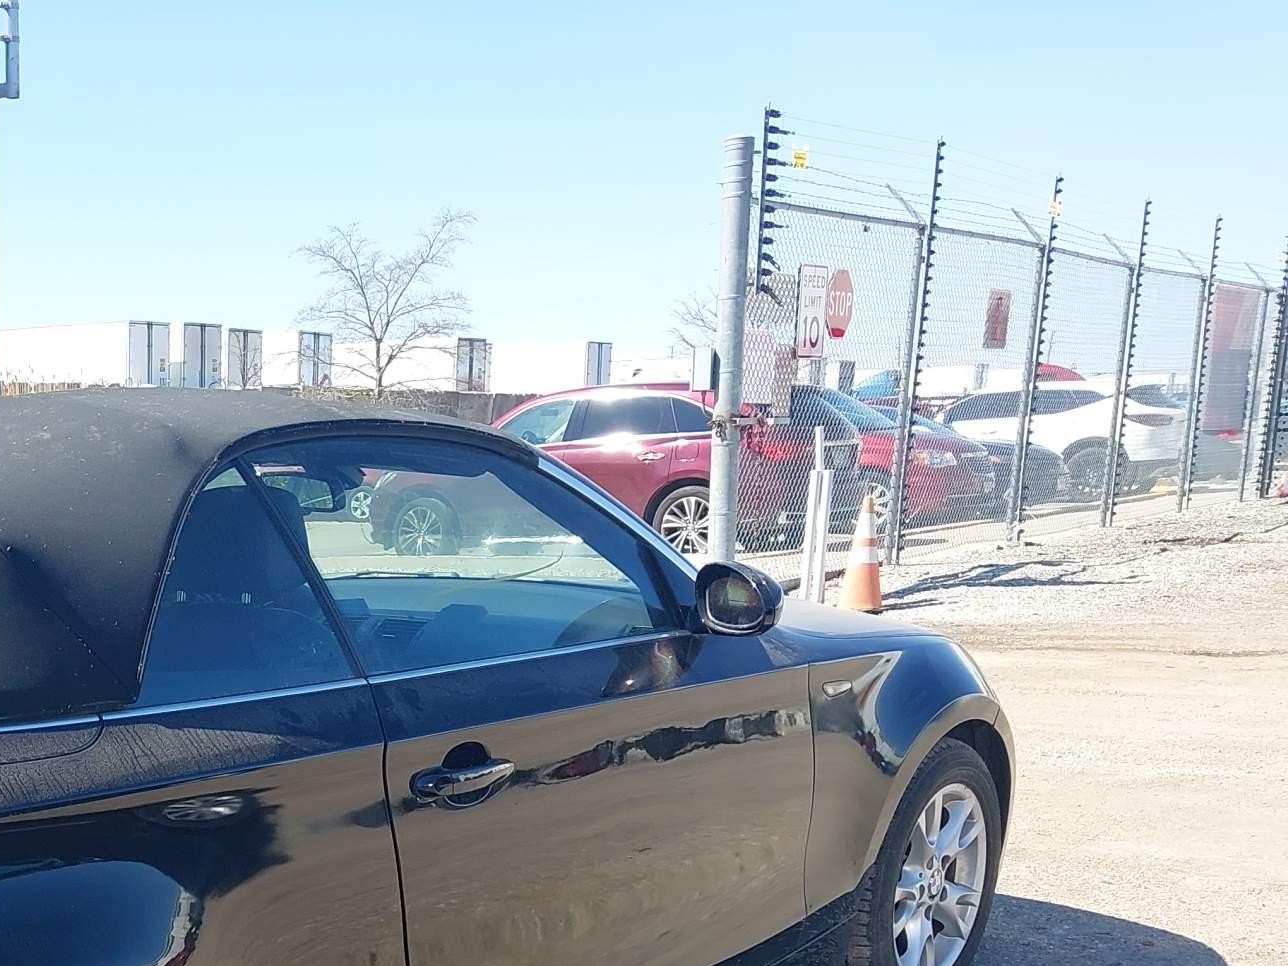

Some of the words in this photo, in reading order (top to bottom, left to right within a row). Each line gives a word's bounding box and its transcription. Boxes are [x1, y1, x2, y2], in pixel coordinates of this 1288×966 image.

[803, 274, 826, 289] SPEED
[804, 295, 823, 309] LIMIT
[828, 290, 853, 317] STOP
[803, 315, 820, 349] 10
